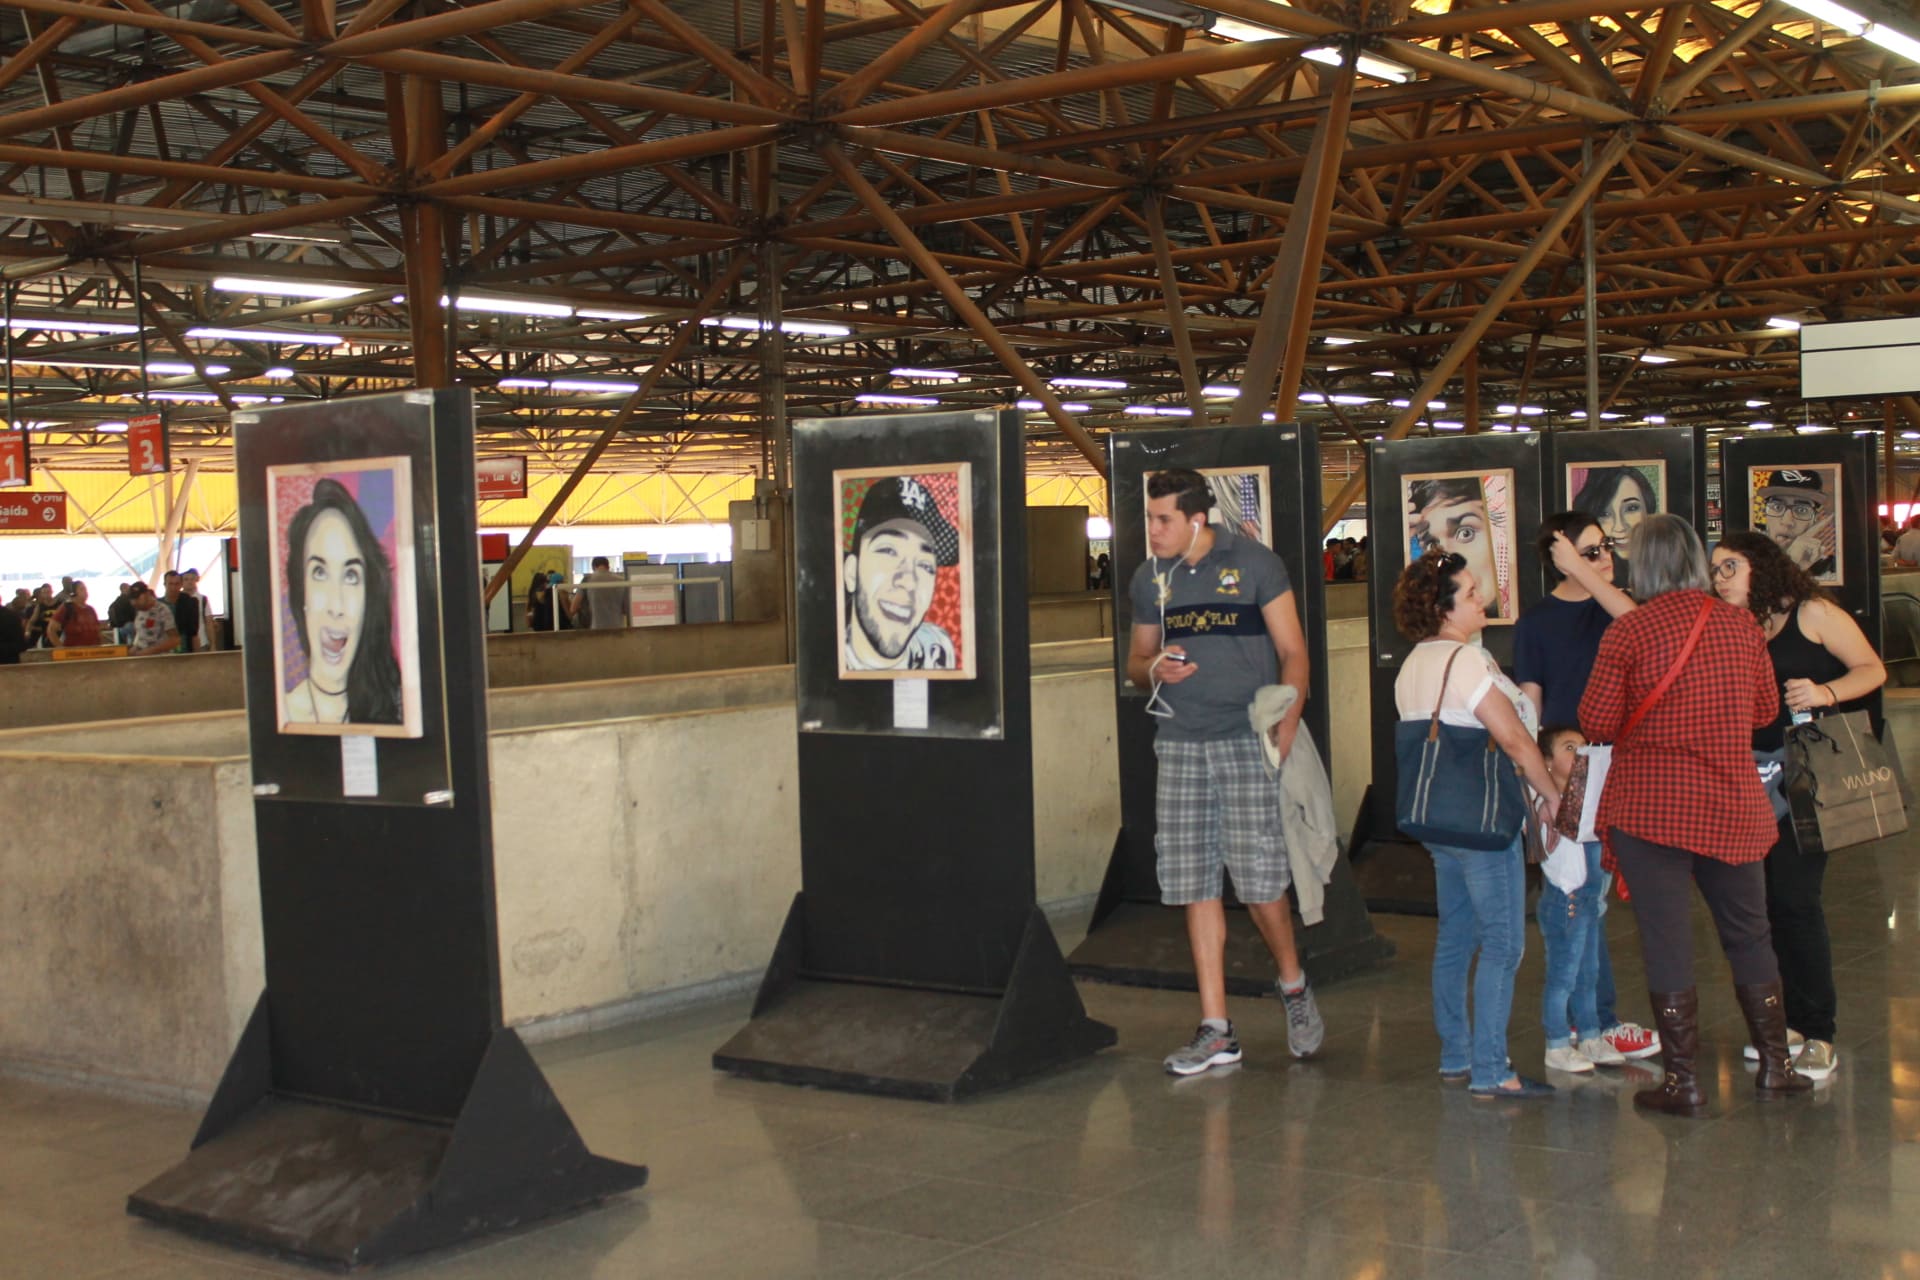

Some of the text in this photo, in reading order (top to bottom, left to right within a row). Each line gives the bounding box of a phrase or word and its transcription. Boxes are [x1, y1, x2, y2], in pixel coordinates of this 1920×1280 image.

[5, 454, 15, 480] 1
[140, 439, 154, 470] 3
[898, 476, 926, 511] LA
[1166, 612, 1239, 629] POLO PLAY
